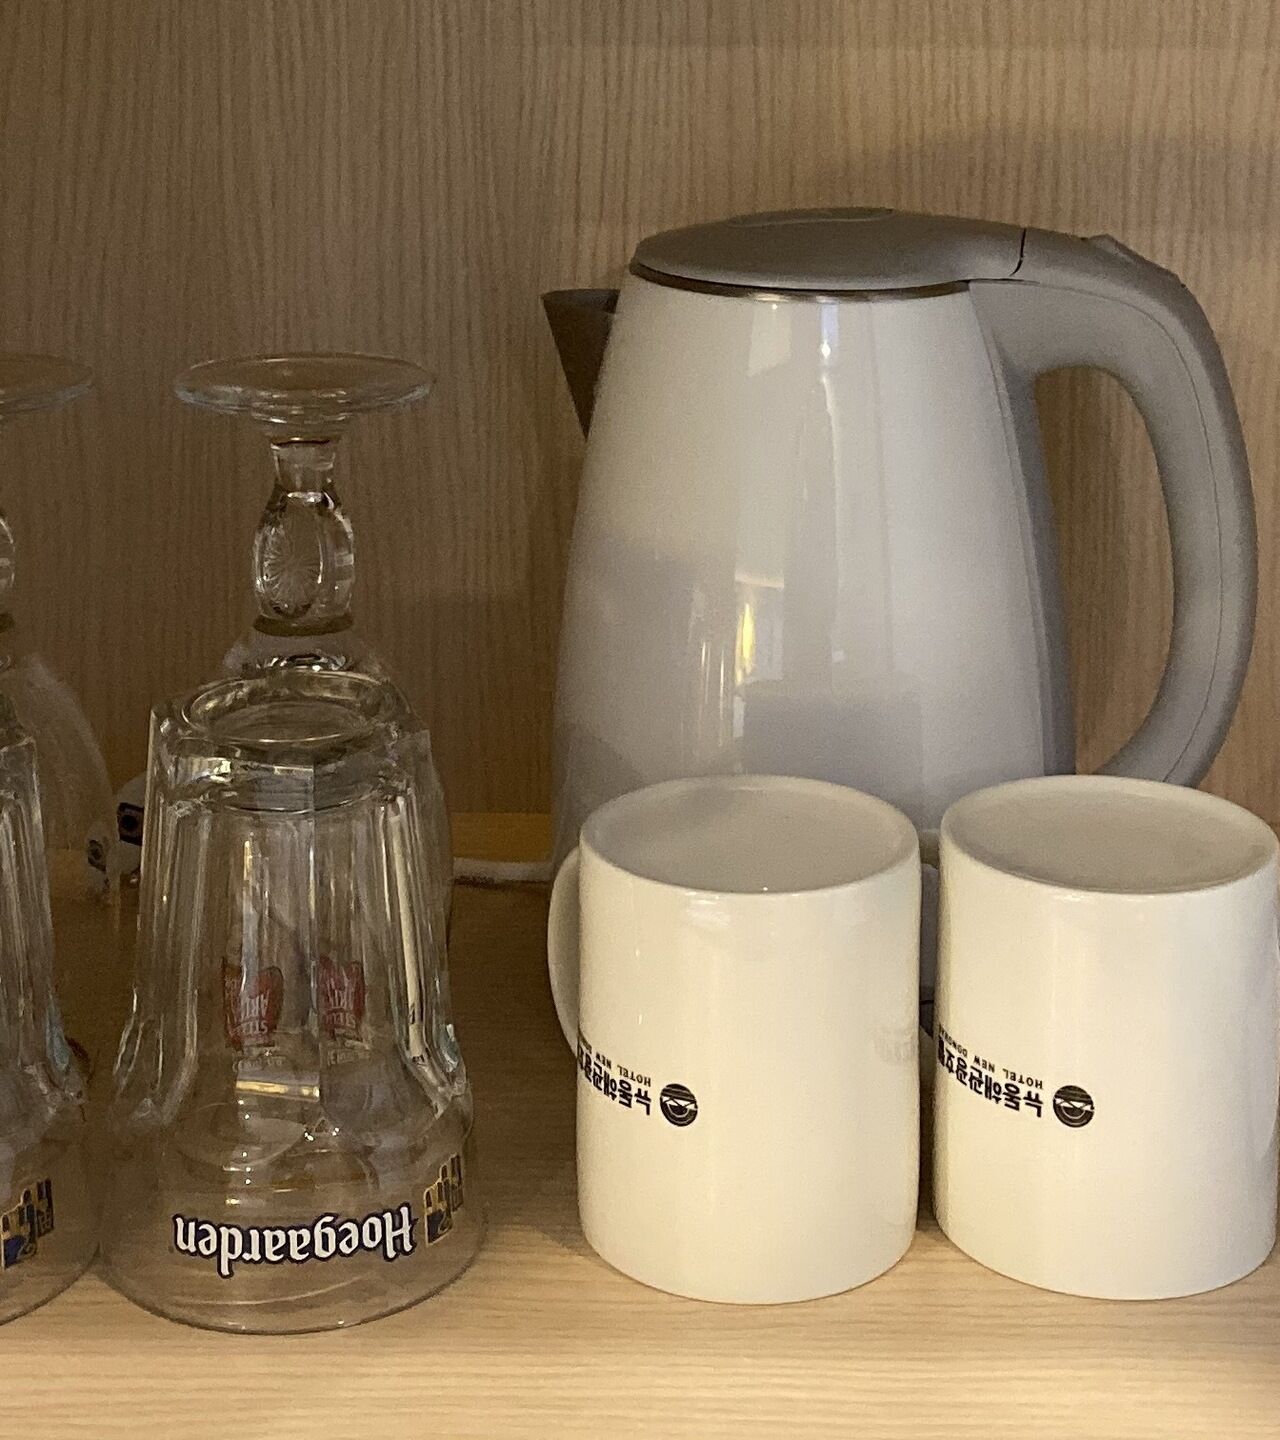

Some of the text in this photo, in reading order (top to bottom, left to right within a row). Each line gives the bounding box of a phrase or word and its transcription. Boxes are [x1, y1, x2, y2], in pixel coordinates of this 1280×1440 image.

[616, 1063, 652, 1088] HOTEL
[973, 1054, 996, 1074] NEW
[1002, 1067, 1044, 1090] HOTEL
[172, 1203, 417, 1278] Hoegaarden
